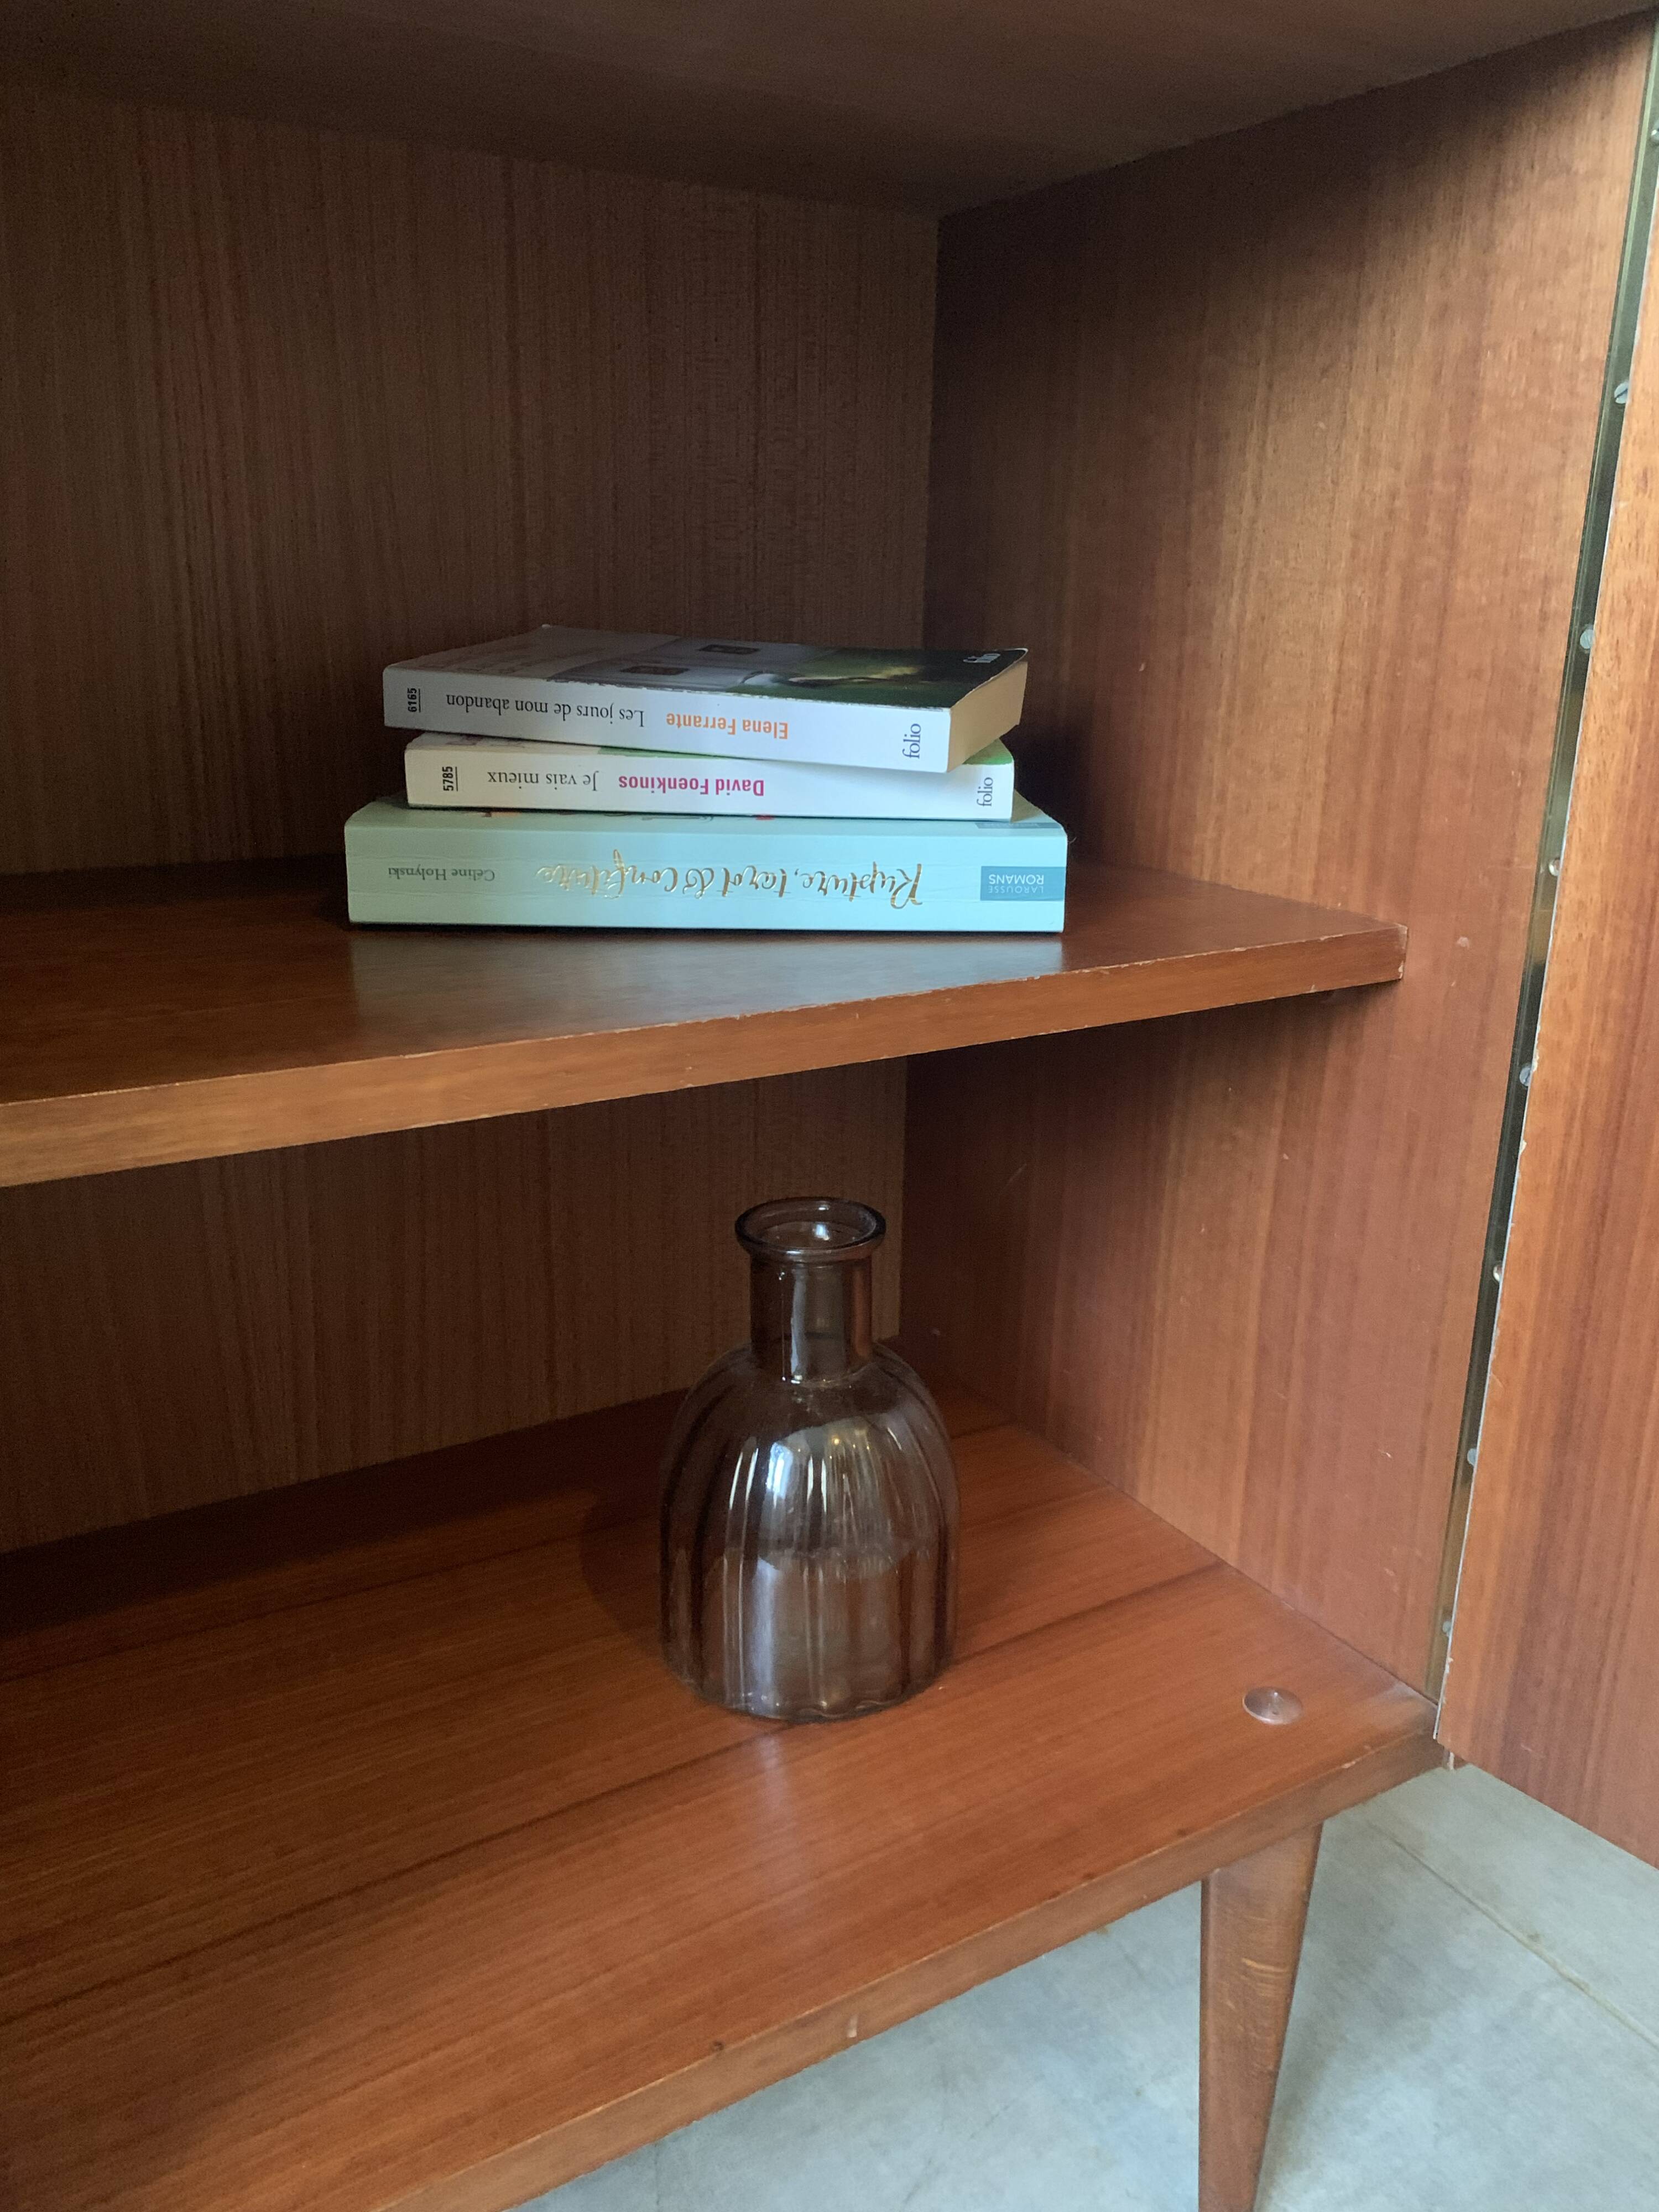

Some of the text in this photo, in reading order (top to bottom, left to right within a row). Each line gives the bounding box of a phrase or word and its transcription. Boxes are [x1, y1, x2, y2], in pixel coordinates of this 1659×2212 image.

[407, 687, 417, 713] 6165
[446, 695, 645, 727] Les jours de mon abandon
[666, 712, 788, 739] Elena Ferrante
[902, 723, 921, 759] folio
[442, 766, 454, 791] 5785
[487, 770, 599, 791] Je vais mieux
[618, 776, 764, 796] David Foenkinos
[977, 776, 993, 807] folio
[388, 864, 495, 881] Céline Holynski
[717, 865, 791, 898] tarot
[988, 874, 1044, 885] ROMANS
